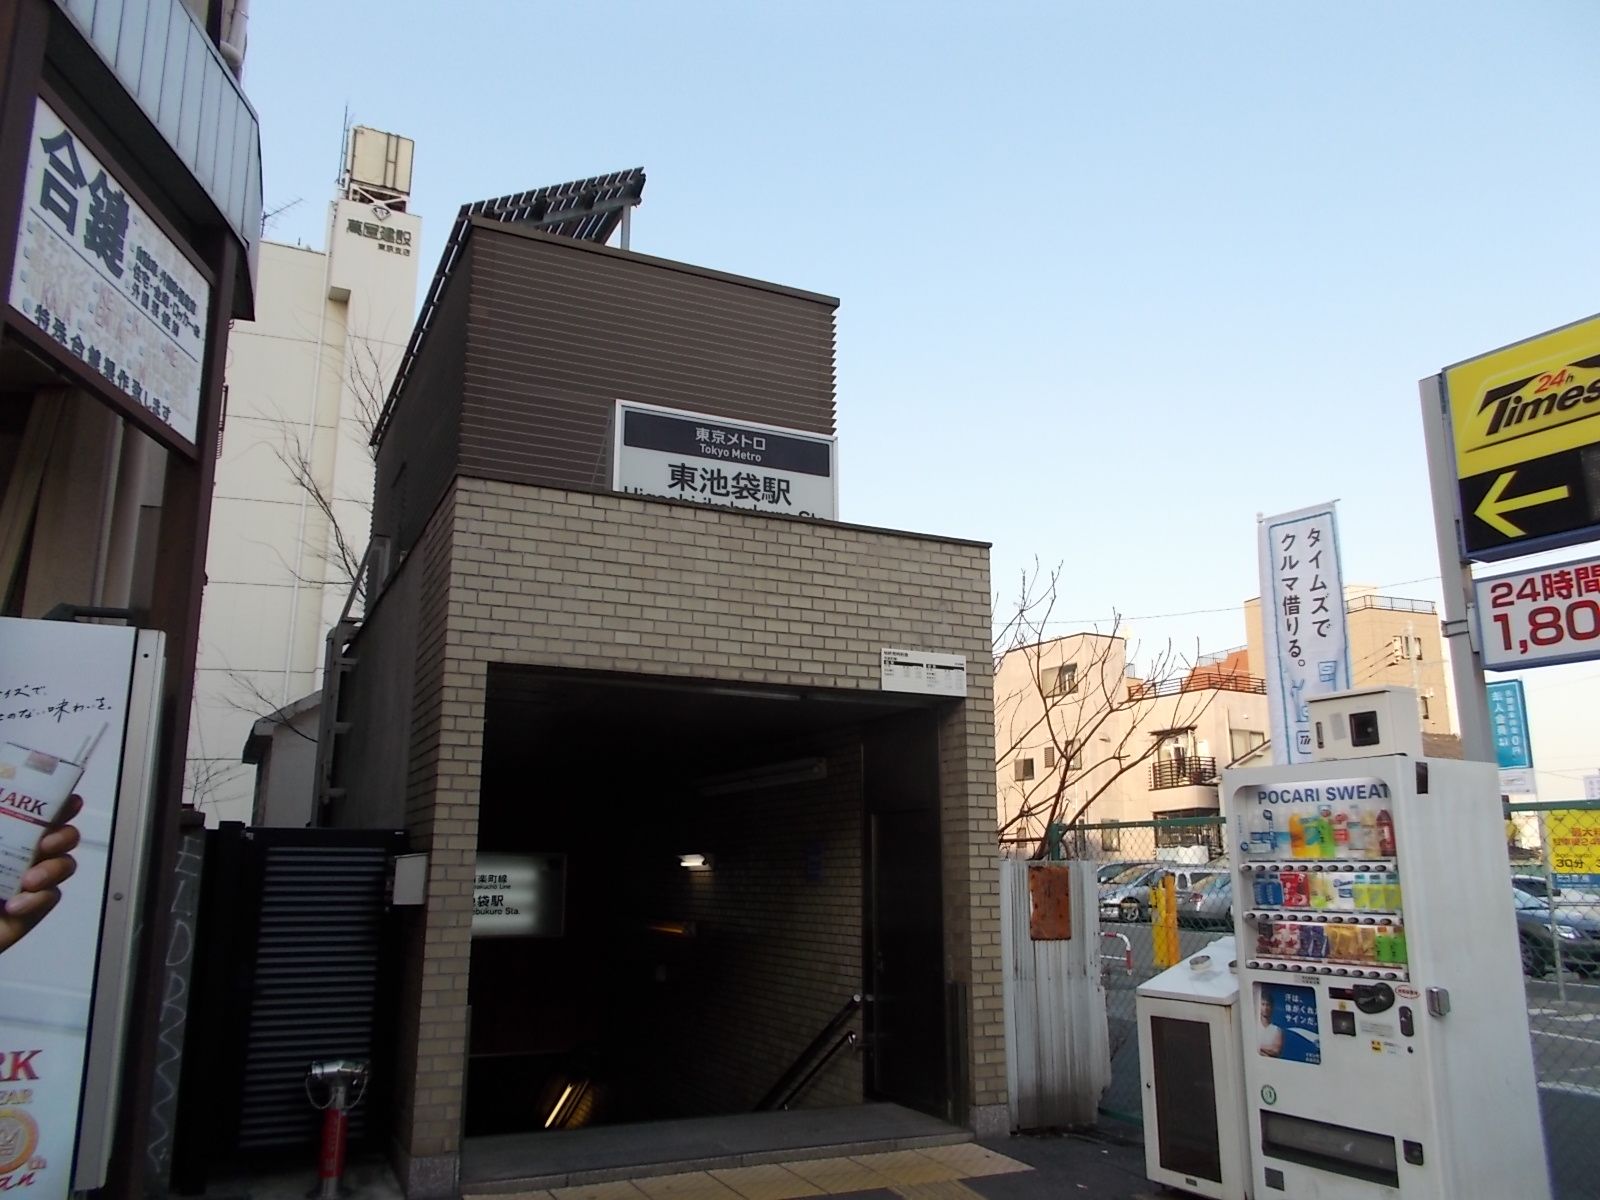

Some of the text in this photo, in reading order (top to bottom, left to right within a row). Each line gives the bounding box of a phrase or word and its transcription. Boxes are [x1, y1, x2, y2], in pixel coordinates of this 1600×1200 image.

[40, 129, 129, 279] 合鍵
[1477, 371, 1600, 436] Times
[695, 427, 766, 451] 東京メトロ
[699, 443, 762, 463] Tokyo Metro
[667, 462, 792, 506] 東池袋駅
[1306, 527, 1331, 638] タイムズで
[1280, 533, 1306, 667] クルマ借りる。
[1258, 783, 1390, 805] POCARI SWEAT
[473, 874, 508, 884] 楽町線
[473, 894, 504, 907] 袋駅
